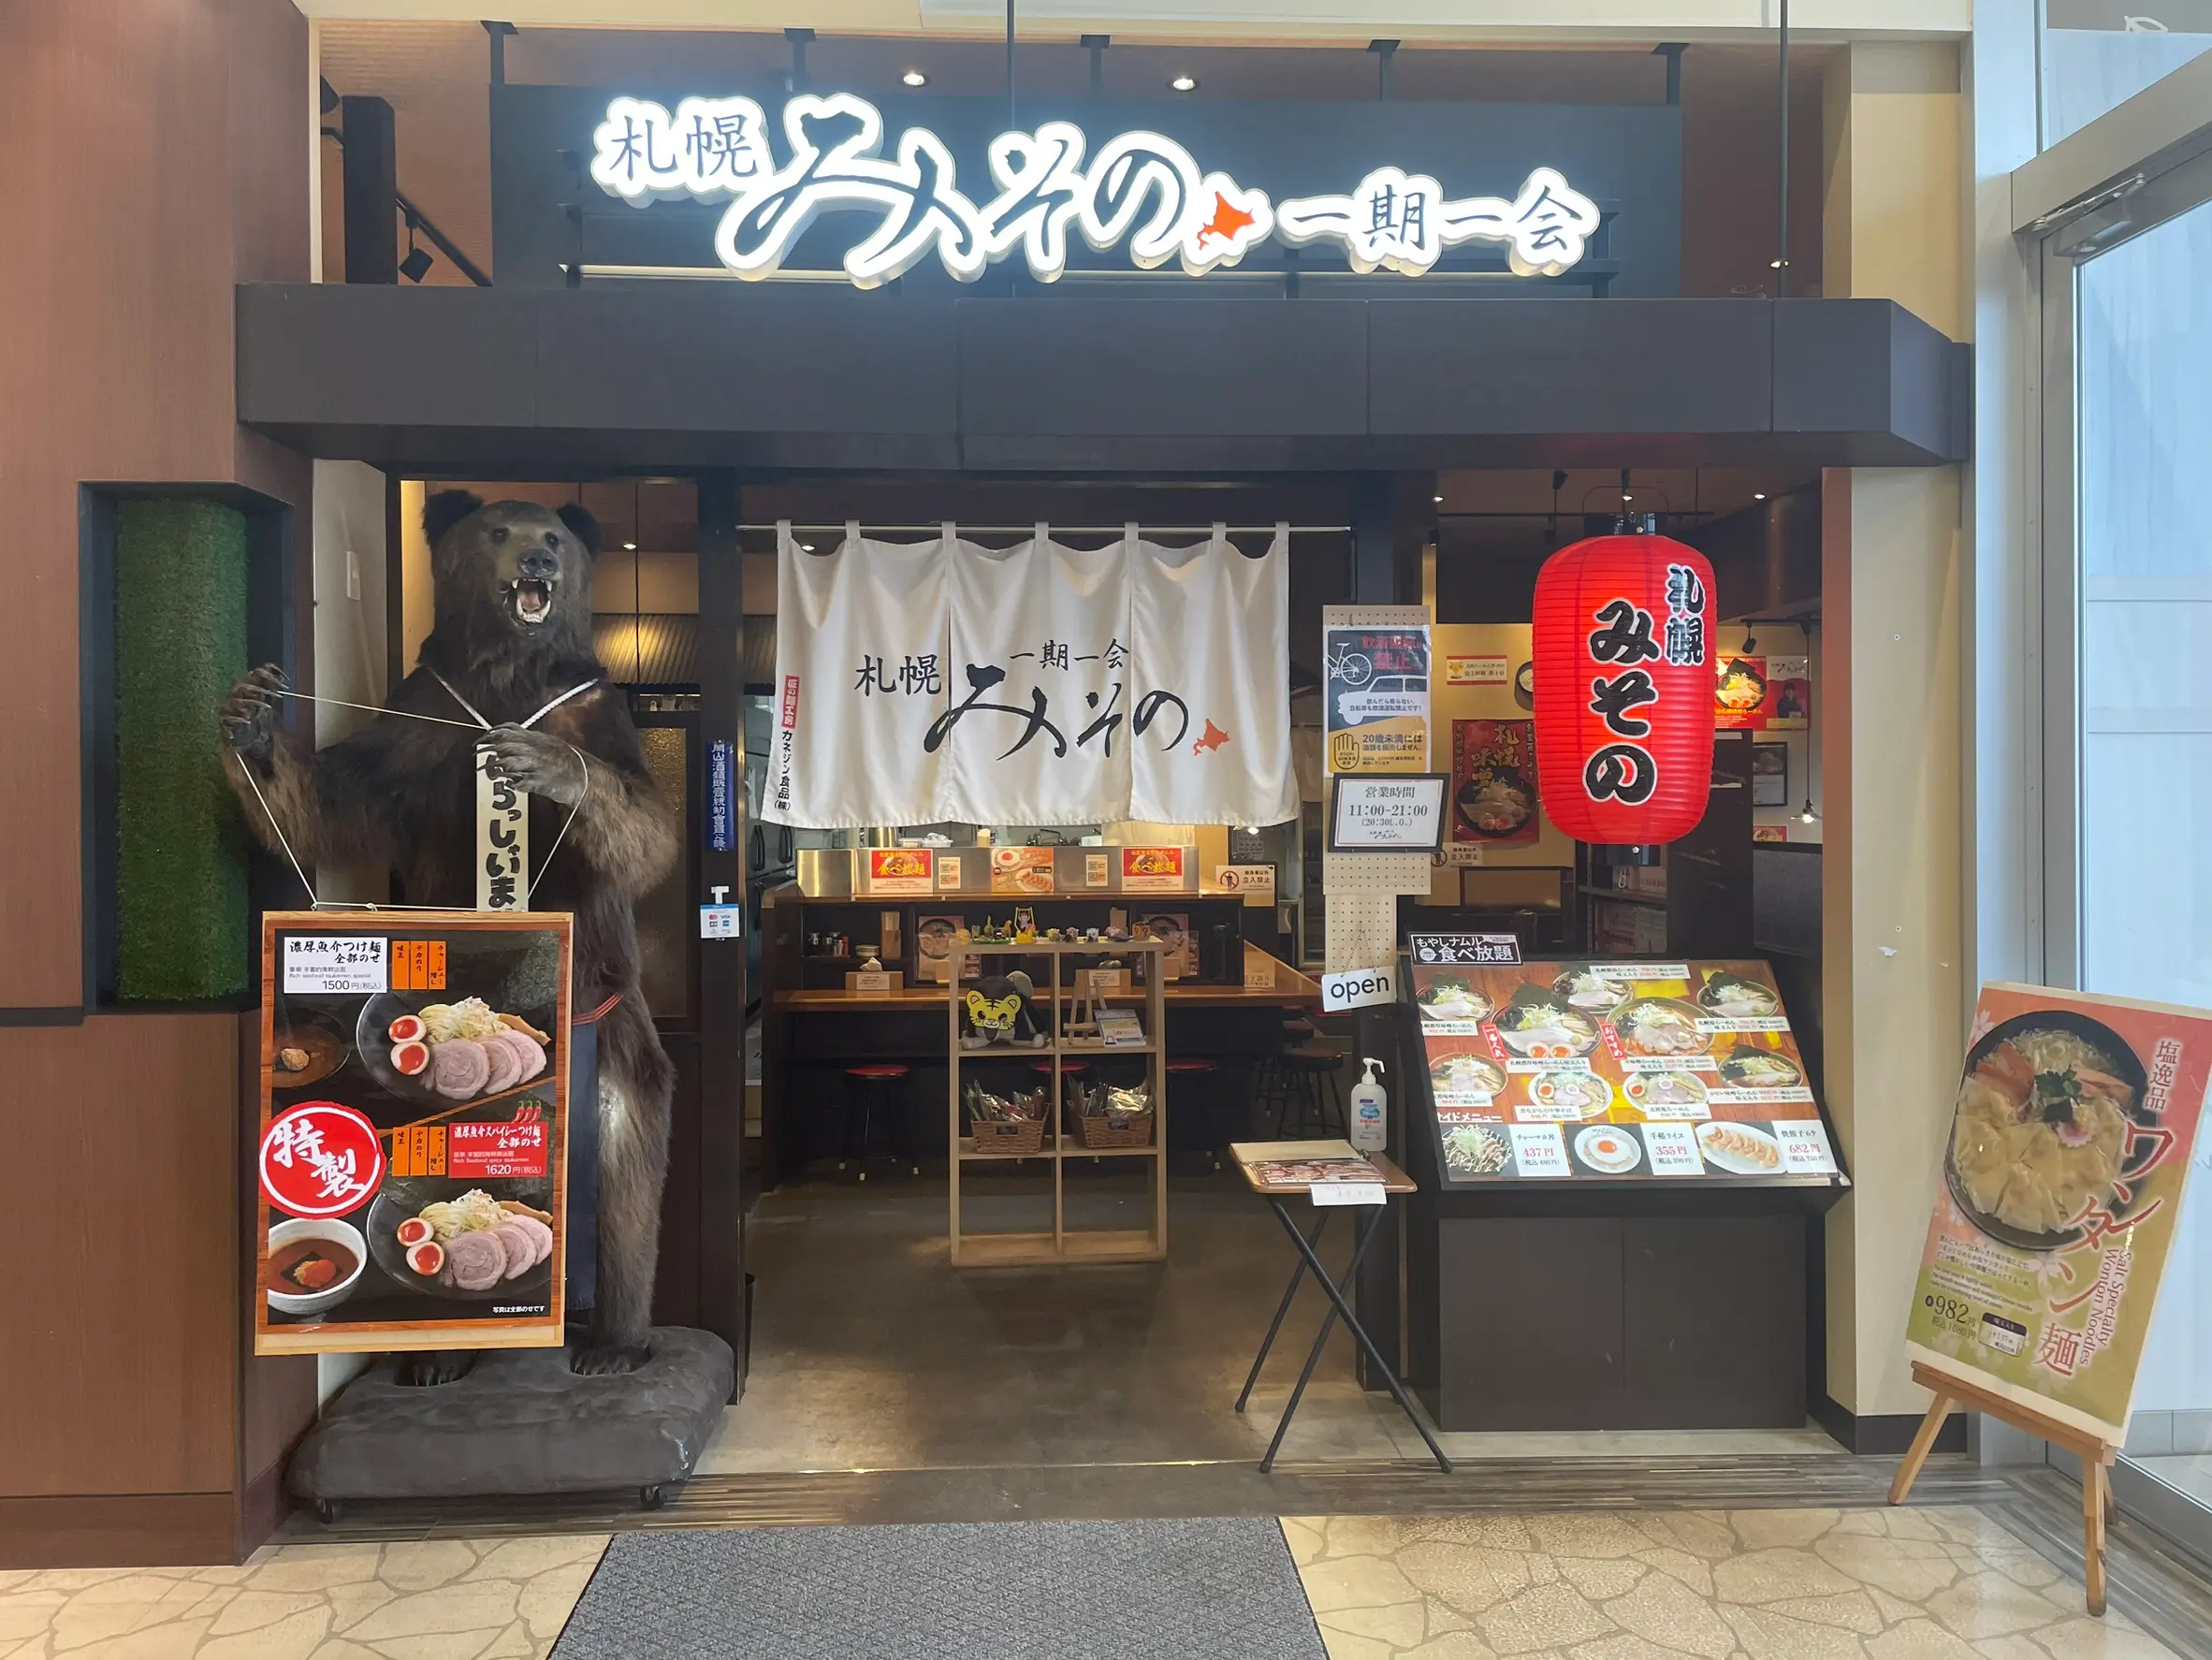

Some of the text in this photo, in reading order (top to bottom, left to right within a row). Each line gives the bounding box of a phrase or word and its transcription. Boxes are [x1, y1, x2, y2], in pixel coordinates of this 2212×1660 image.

[610, 109, 1584, 266] 札幌 みその 一期一会
[1666, 563, 1705, 665] 札幌
[1009, 638, 1130, 671] 一期一会
[854, 654, 1187, 761] 札幌 みその
[1583, 598, 1661, 806] みその
[1362, 734, 1422, 743] 20歳未満には
[1365, 786, 1415, 798] 営業時間
[1349, 805, 1428, 816] 11:00-21:00
[486, 753, 521, 912] いらっしゃいま
[1451, 852, 1479, 861] 立入禁止
[290, 940, 382, 954] 濃厚魚介つけ麺
[1416, 937, 1484, 948] もやしナムル
[1439, 945, 1514, 962] 食べ放題
[334, 953, 381, 964] 全部のせ
[1331, 974, 1390, 1003] open
[1485, 1026, 1506, 1058] 一番人気
[1603, 1027, 1624, 1057] おすすめ
[2145, 1040, 2181, 1110] 塩逸品
[454, 1125, 542, 1138] 濃厚魚介スパイシーつけ麺
[497, 1137, 543, 1149] 全部のせ
[265, 1118, 367, 1199] 特製
[1522, 1147, 1555, 1158] 437円
[1655, 1145, 1688, 1157] 355円
[1789, 1143, 1822, 1154] 682円
[2079, 1248, 2119, 1366] Wonton Noodles
[2099, 1251, 2132, 1347] Salt Specialty
